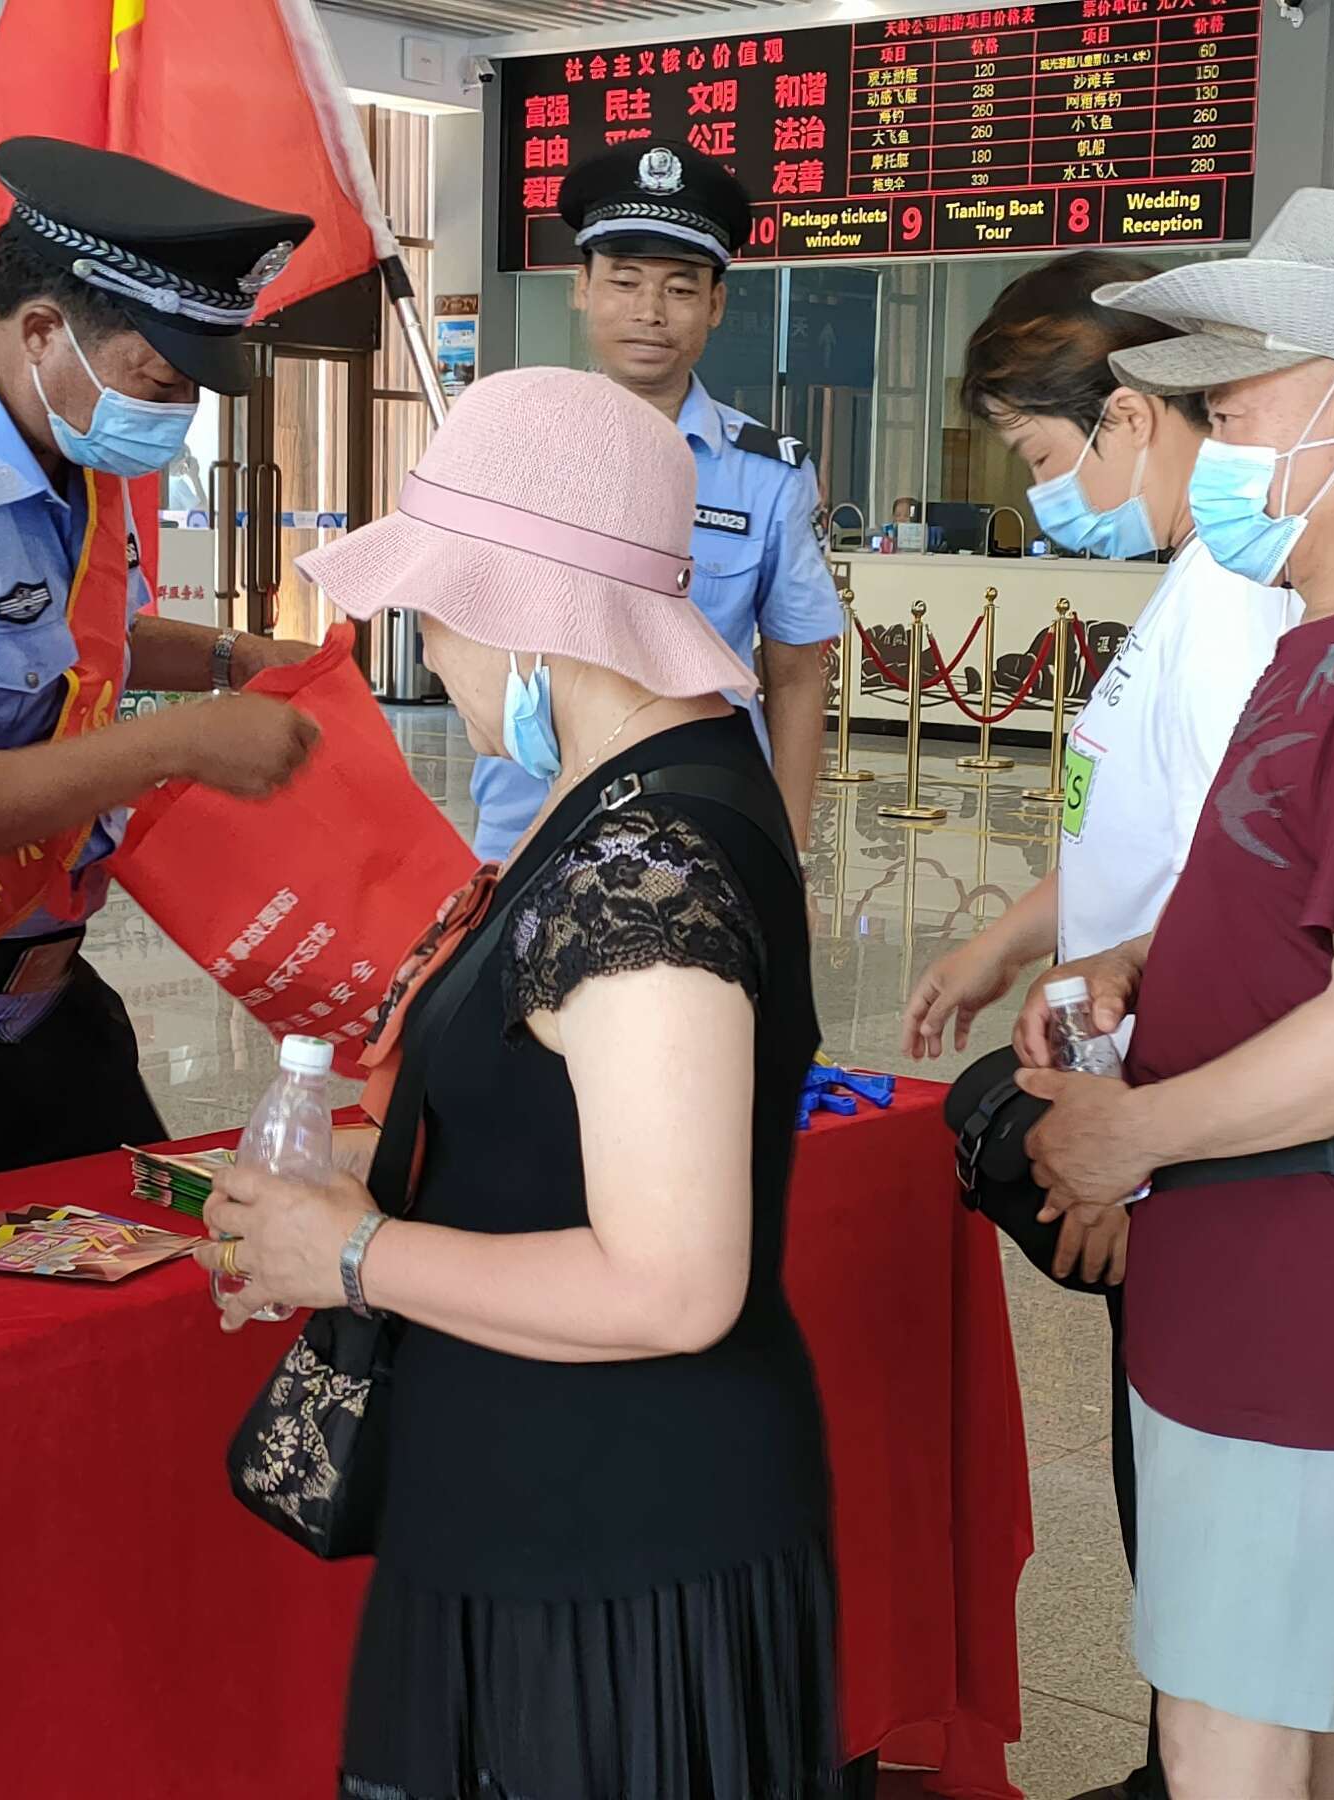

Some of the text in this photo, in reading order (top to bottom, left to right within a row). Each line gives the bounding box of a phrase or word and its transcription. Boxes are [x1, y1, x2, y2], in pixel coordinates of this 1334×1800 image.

[1194, 15, 1225, 36] 价格
[1081, 26, 1110, 45] 项目
[880, 46, 907, 64] 项目
[971, 36, 999, 55] 价格
[1198, 43, 1216, 58] 60
[565, 38, 785, 82] 社会主义核心价值观
[867, 67, 918, 87] 观光游艇
[974, 63, 995, 78] 120
[1195, 64, 1220, 80] 150
[774, 71, 828, 109] 和谐
[1073, 72, 1116, 90] 沙滩车
[687, 79, 738, 116] 文明
[867, 88, 918, 107] 动感飞艇
[972, 84, 994, 99] 258
[1195, 86, 1219, 100] 130
[524, 94, 569, 129] 富强
[605, 88, 652, 122] 民主
[971, 103, 994, 118] 260
[879, 109, 904, 125] 海钓
[1071, 114, 1113, 133] 小飞鱼
[1193, 108, 1217, 124] 260
[687, 121, 737, 156] 公正
[773, 115, 826, 152] 法治
[871, 129, 910, 147] 大飞鱼
[970, 125, 994, 140] 260
[1192, 134, 1216, 150] 200
[524, 134, 569, 169] 自由
[971, 149, 992, 164] 180
[1077, 138, 1106, 158] 帆船
[870, 152, 910, 171] 摩托艇
[1190, 157, 1215, 174] 280
[772, 160, 825, 195] 友善
[971, 174, 989, 187] 330
[1062, 162, 1119, 181] 水上飞人
[872, 176, 906, 192] 拖曳伞
[1126, 190, 1201, 211] Wedding
[782, 207, 888, 230] Package tickets
[945, 200, 1044, 221] Tianling Boat
[1069, 198, 1090, 233] 8
[748, 216, 776, 245] 10
[902, 207, 923, 241] 9
[975, 225, 1012, 241] Tour
[1122, 214, 1203, 236] Reception
[805, 230, 861, 248] window
